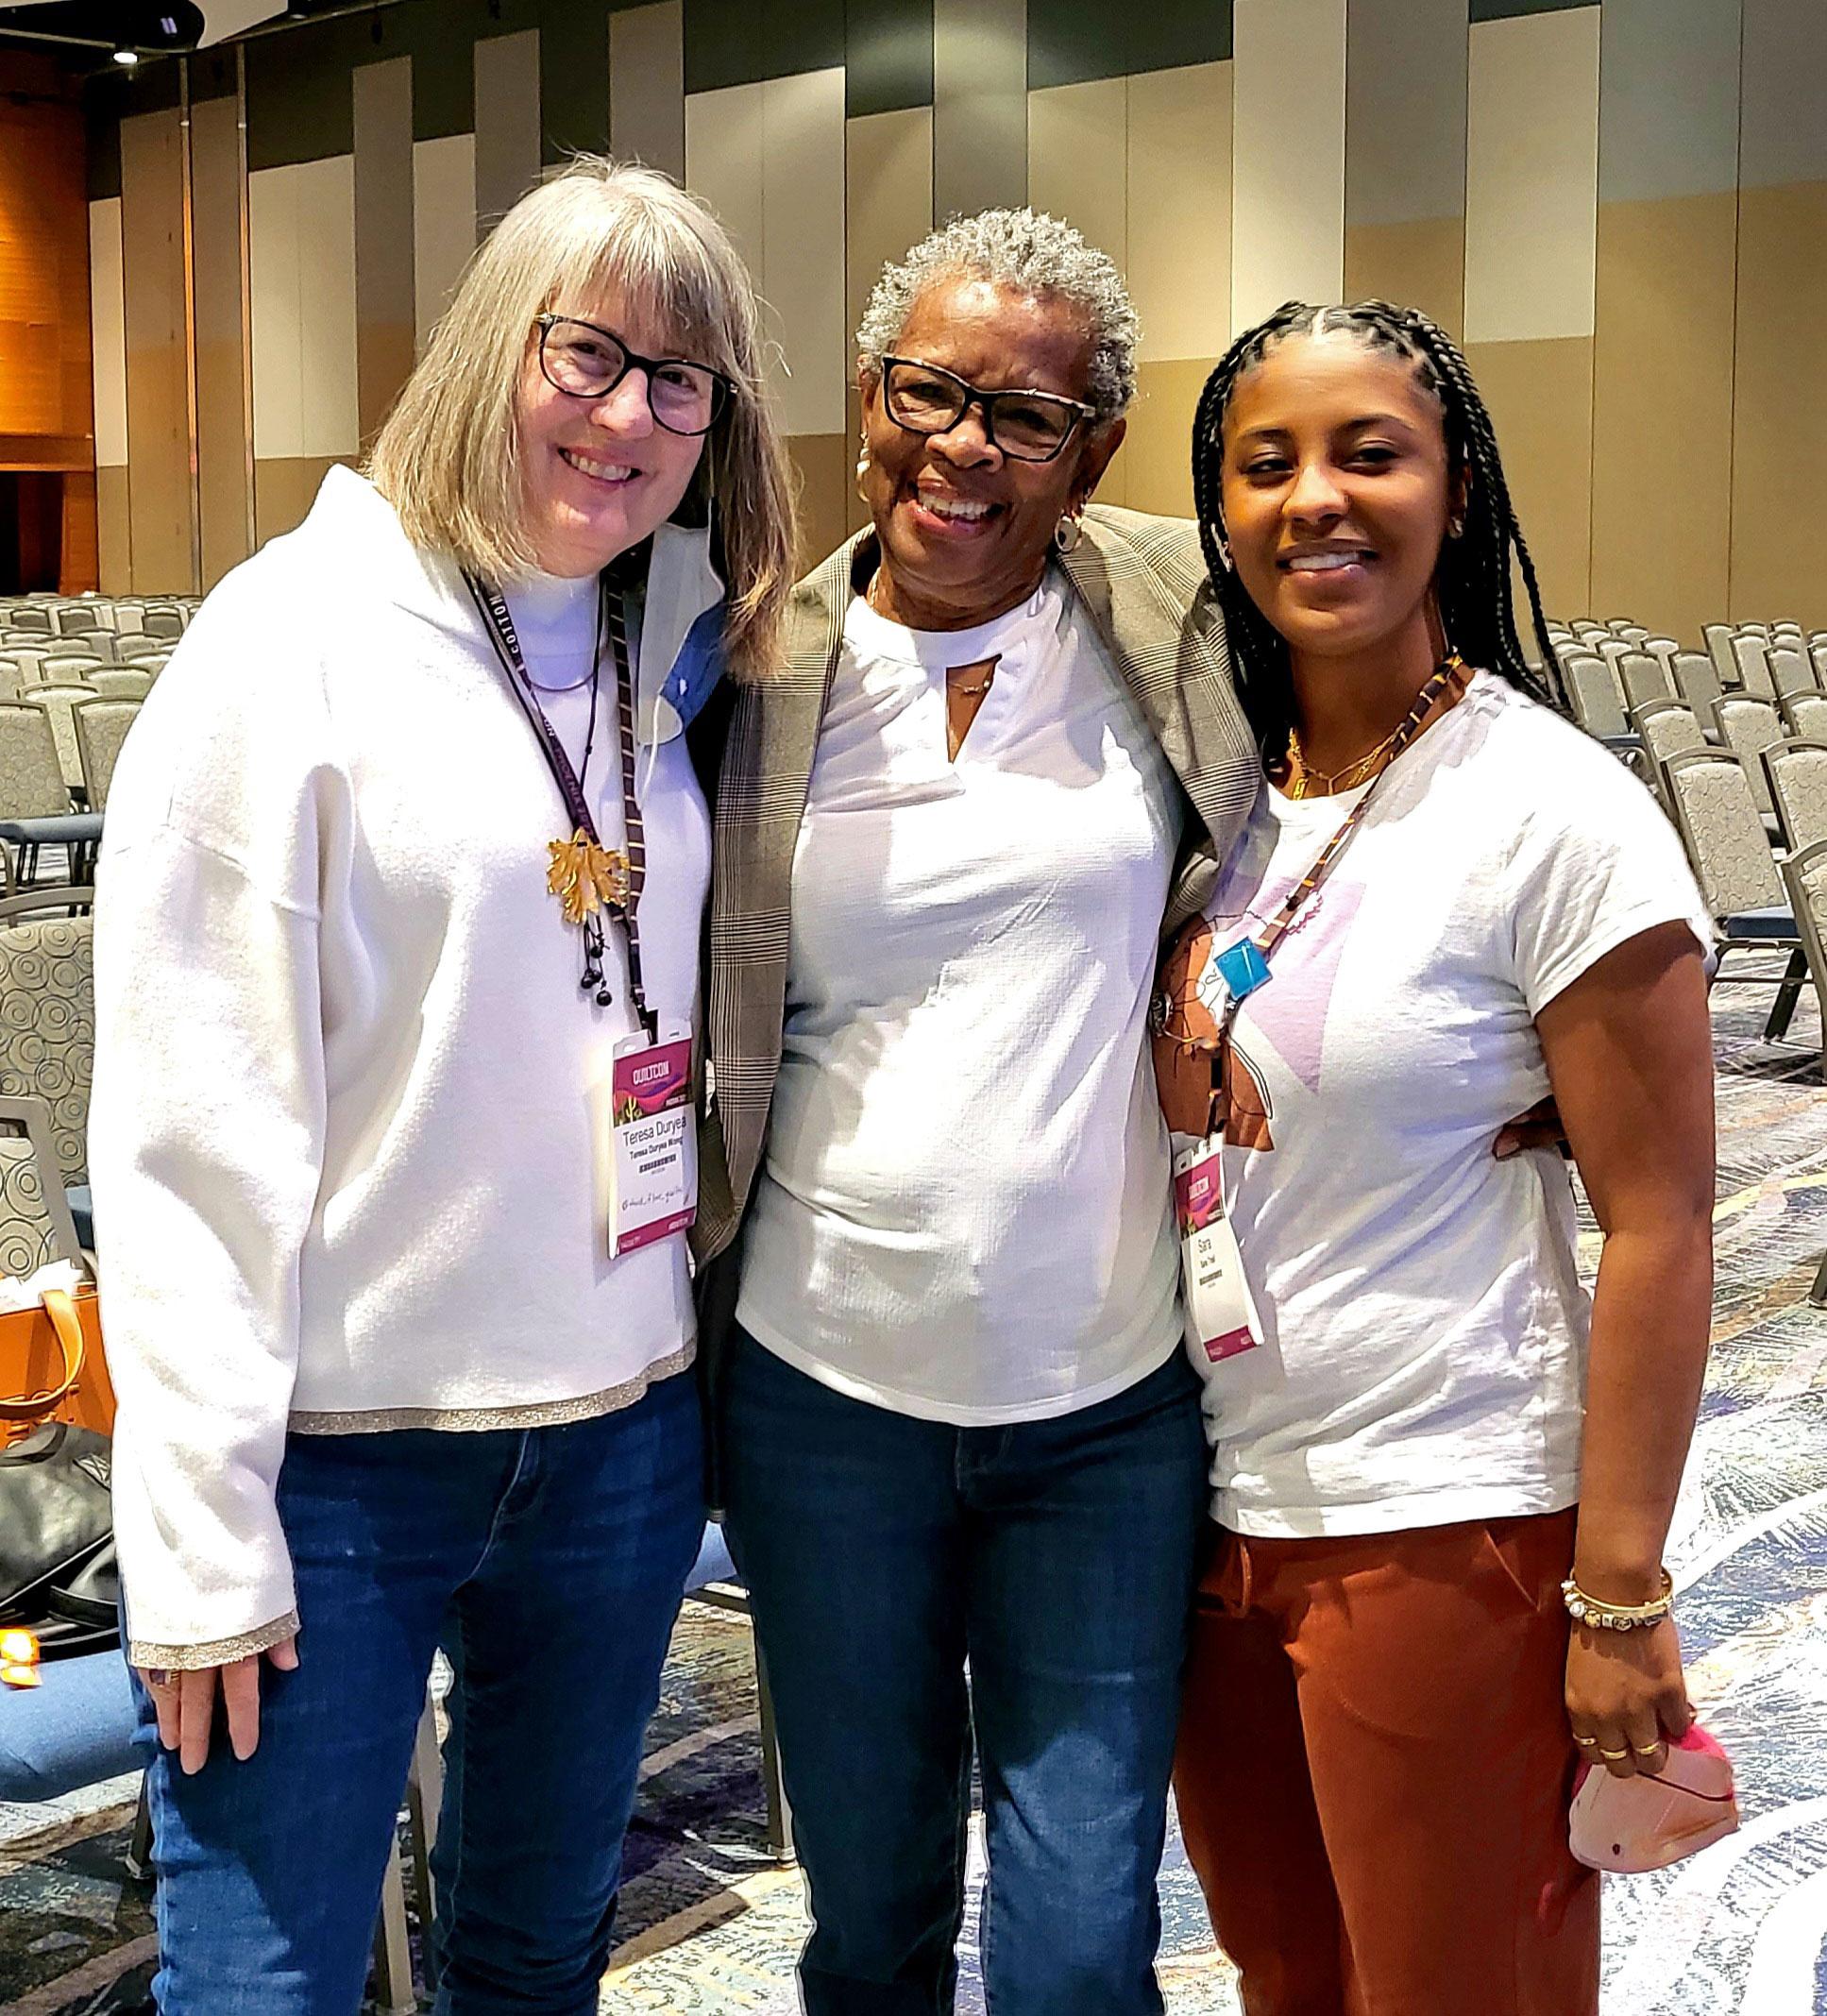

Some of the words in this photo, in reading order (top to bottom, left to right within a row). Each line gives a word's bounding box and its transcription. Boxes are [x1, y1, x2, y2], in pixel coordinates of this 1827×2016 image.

[633, 1060, 669, 1085] QUILTCON
[623, 1127, 654, 1146] Teresa
[656, 1116, 687, 1136] Duryea
